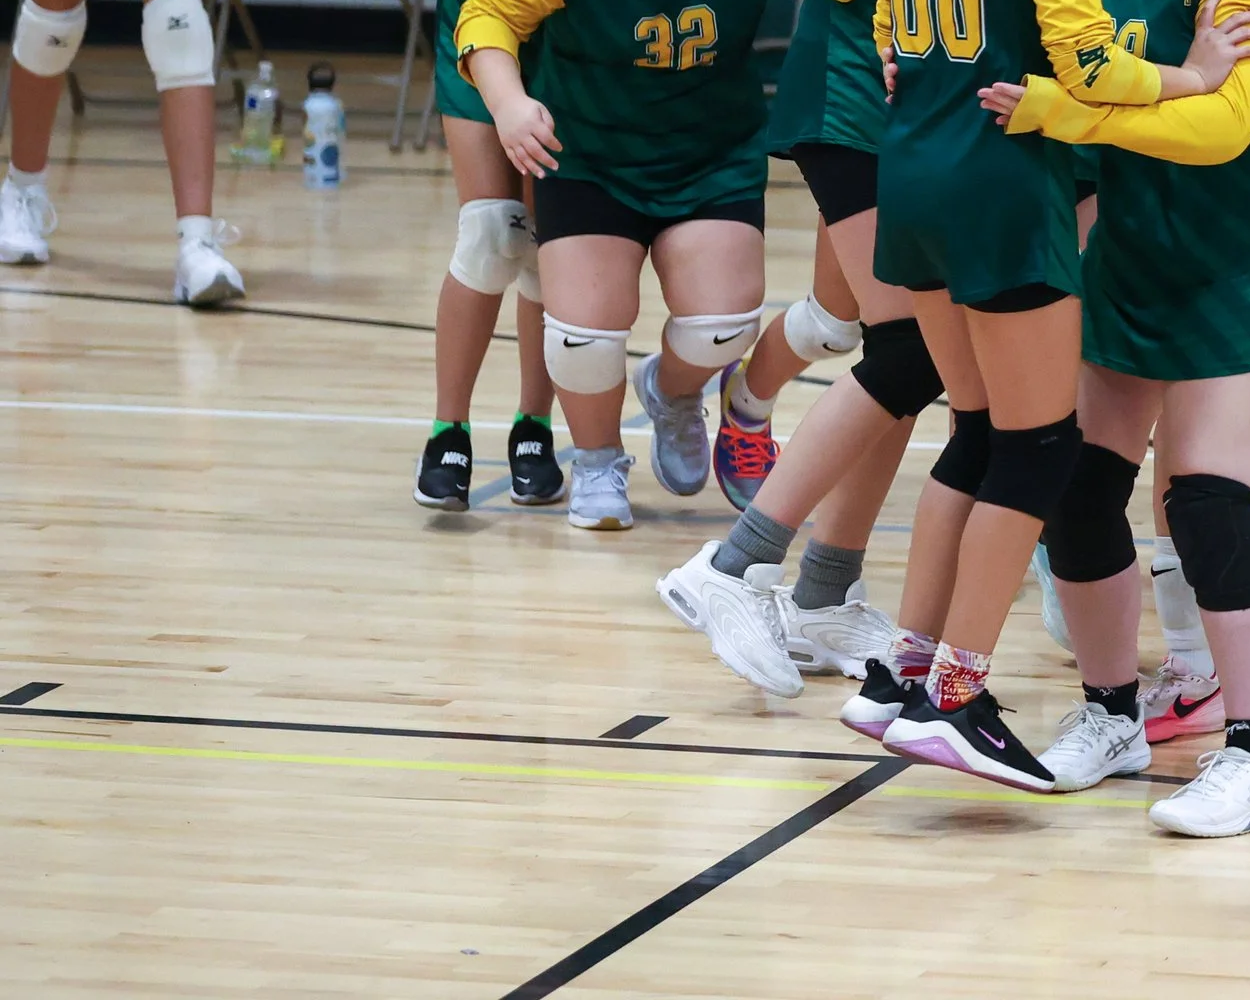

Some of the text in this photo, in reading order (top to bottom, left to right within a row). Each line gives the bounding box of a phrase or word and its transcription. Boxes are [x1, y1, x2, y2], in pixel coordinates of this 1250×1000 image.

[634, 4, 718, 70] 32
[516, 441, 543, 457] NIKE
[441, 451, 468, 468] NIKE
